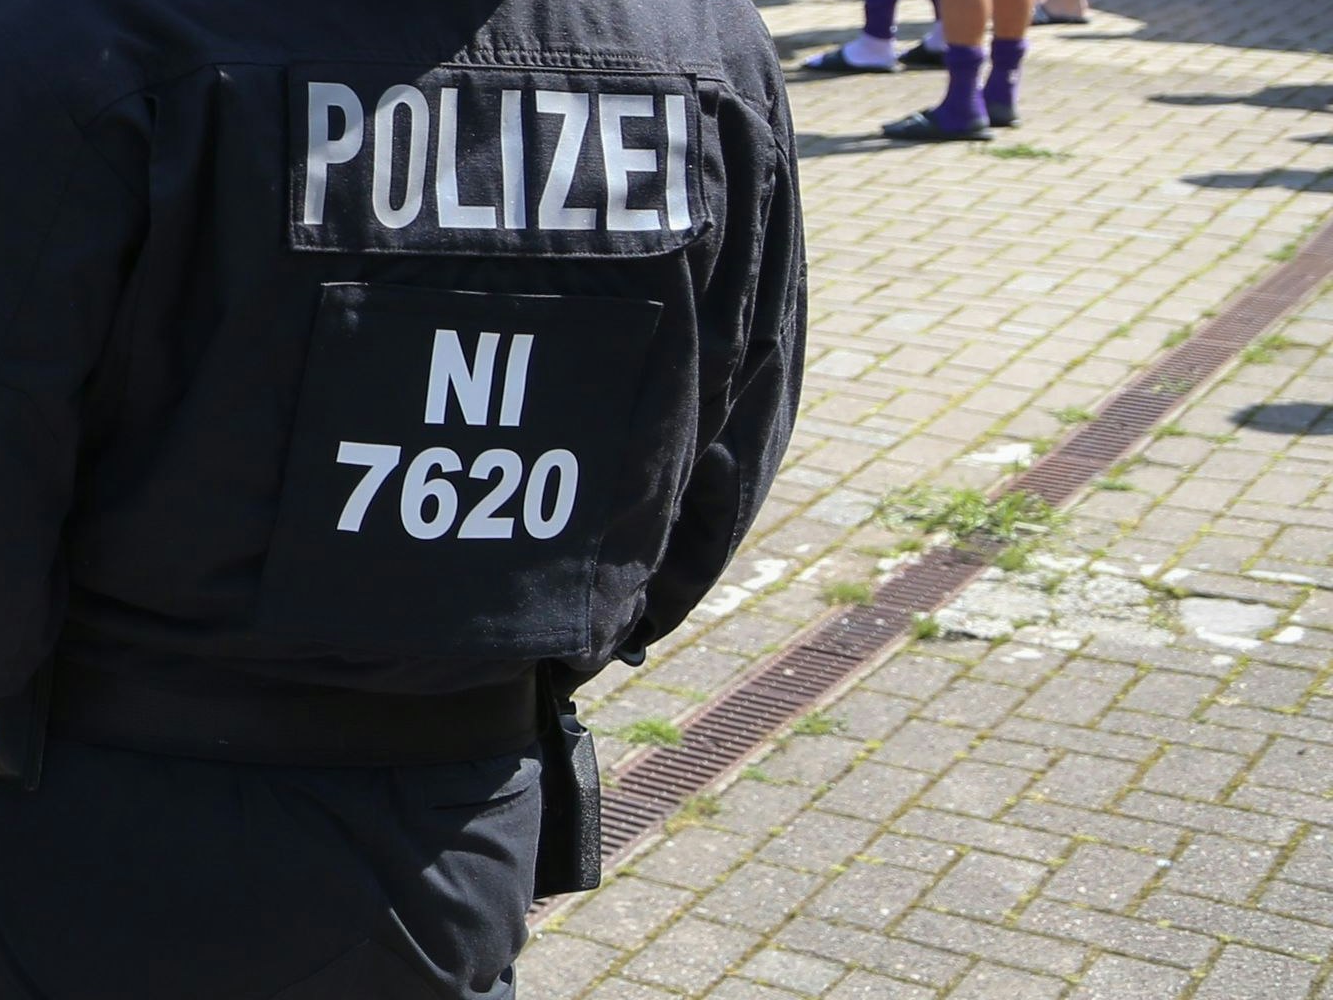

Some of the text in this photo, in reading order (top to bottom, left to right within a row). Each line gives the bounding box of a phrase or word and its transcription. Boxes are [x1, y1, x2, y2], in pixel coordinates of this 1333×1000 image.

[303, 81, 693, 232] POLIZEI
[424, 328, 535, 427] NI
[336, 440, 579, 540] 7620
